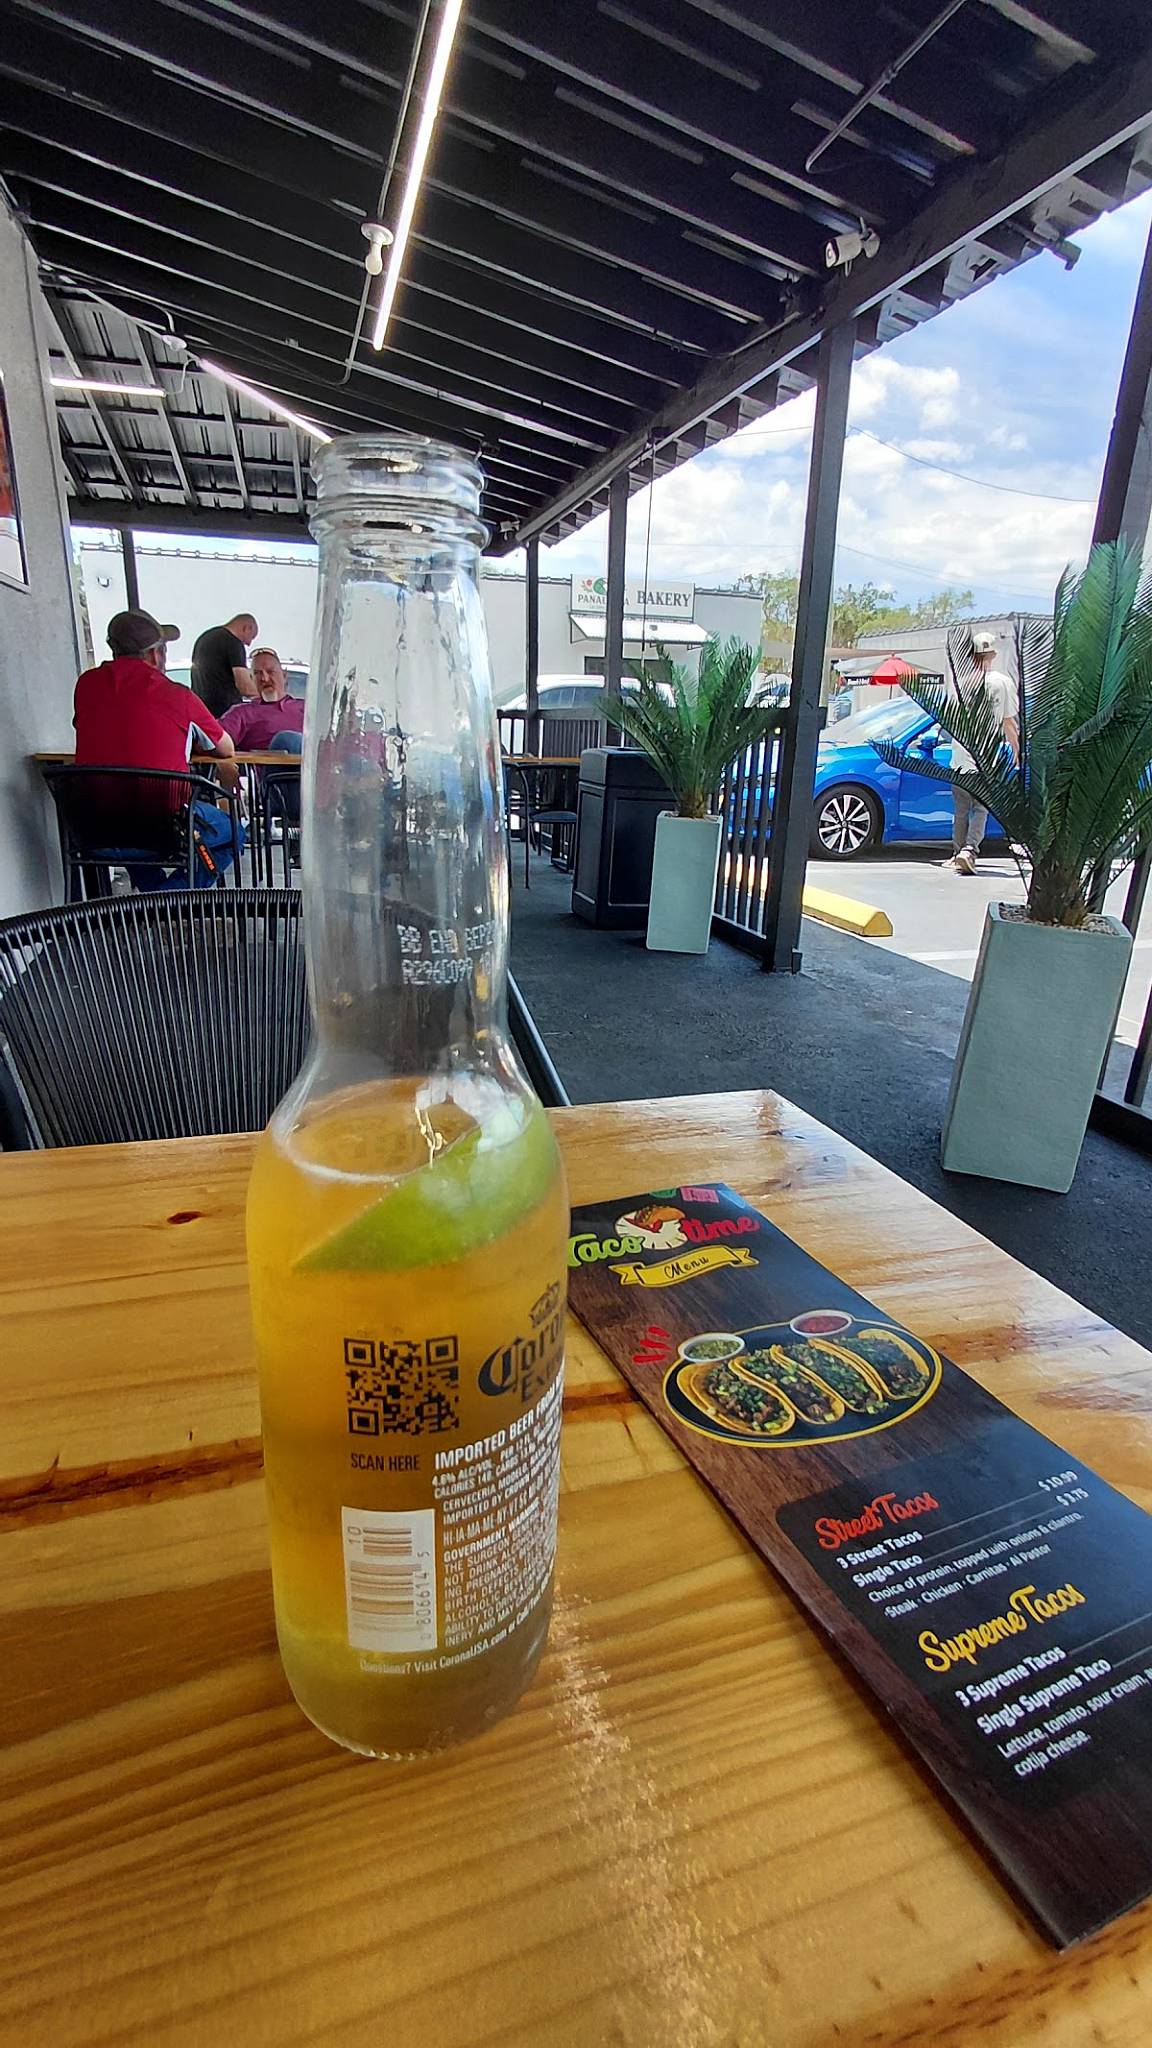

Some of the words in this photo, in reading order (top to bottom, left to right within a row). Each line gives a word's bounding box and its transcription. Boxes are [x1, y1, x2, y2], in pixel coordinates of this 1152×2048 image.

[637, 590, 691, 607] BAKERY
[568, 1233, 646, 1268] Taco
[664, 1255, 709, 1279] Menu
[435, 1429, 506, 1470] IMPORTED
[509, 1408, 535, 1440] BEER
[351, 1453, 385, 1470] SCAN
[388, 1454, 421, 1472] HERE
[434, 1477, 475, 1499] CALORIES
[443, 1484, 497, 1512] CERVECERIA
[443, 1499, 490, 1526] IMPORTED
[491, 1492, 502, 1508] BY
[815, 1504, 884, 1550] Street
[871, 1492, 940, 1524] Tacos
[443, 1526, 506, 1563] GOVERNMENT
[445, 1559, 464, 1575] THE
[466, 1536, 510, 1568] SURGEON
[836, 1557, 849, 1570] 3
[846, 1542, 888, 1566] Street
[883, 1530, 924, 1551] Tacos
[444, 1572, 465, 1588] NOT
[469, 1559, 499, 1580] DRINK
[445, 1585, 463, 1600] ING
[466, 1555, 517, 1594] PREGNANCY
[852, 1565, 895, 1588] Single
[889, 1554, 923, 1573] Taco
[868, 1583, 907, 1603] Choice
[903, 1576, 918, 1590] of
[915, 1563, 957, 1588] protein,
[952, 1548, 990, 1570] topped
[987, 1540, 1013, 1556] with
[1009, 1530, 1042, 1547] onions
[1037, 1524, 1050, 1535] &
[885, 1597, 919, 1619] Steak
[920, 1580, 964, 1604] Chicken
[965, 1561, 1008, 1585] Carnitas
[1009, 1554, 1023, 1567] Al
[1019, 1543, 1052, 1563] Pastor
[444, 1592, 478, 1613] BIRTH
[445, 1589, 502, 1624] ALCOHOLIC
[444, 1614, 481, 1638] ABILITY
[482, 1607, 495, 1621] TO
[445, 1631, 474, 1648] INERY
[477, 1616, 496, 1636] AND
[498, 1601, 515, 1622] MAY
[918, 1610, 1028, 1673] Supreme
[1009, 1583, 1086, 1624] Tacos
[414, 1654, 437, 1674] Visit
[955, 1690, 971, 1708] 3
[966, 1664, 1032, 1702] Supreme
[1022, 1646, 1067, 1673] Tacos
[976, 1702, 1026, 1735] Single
[1018, 1674, 1084, 1713] Supreme
[1074, 1658, 1113, 1683] Taco
[997, 1729, 1050, 1759] Lettuce,
[1043, 1705, 1093, 1734] tomato,
[1086, 1691, 1114, 1712] sour
[1110, 1674, 1151, 1698] cream,
[1014, 1749, 1050, 1777] cotija
[1046, 1729, 1092, 1760] cheese.
